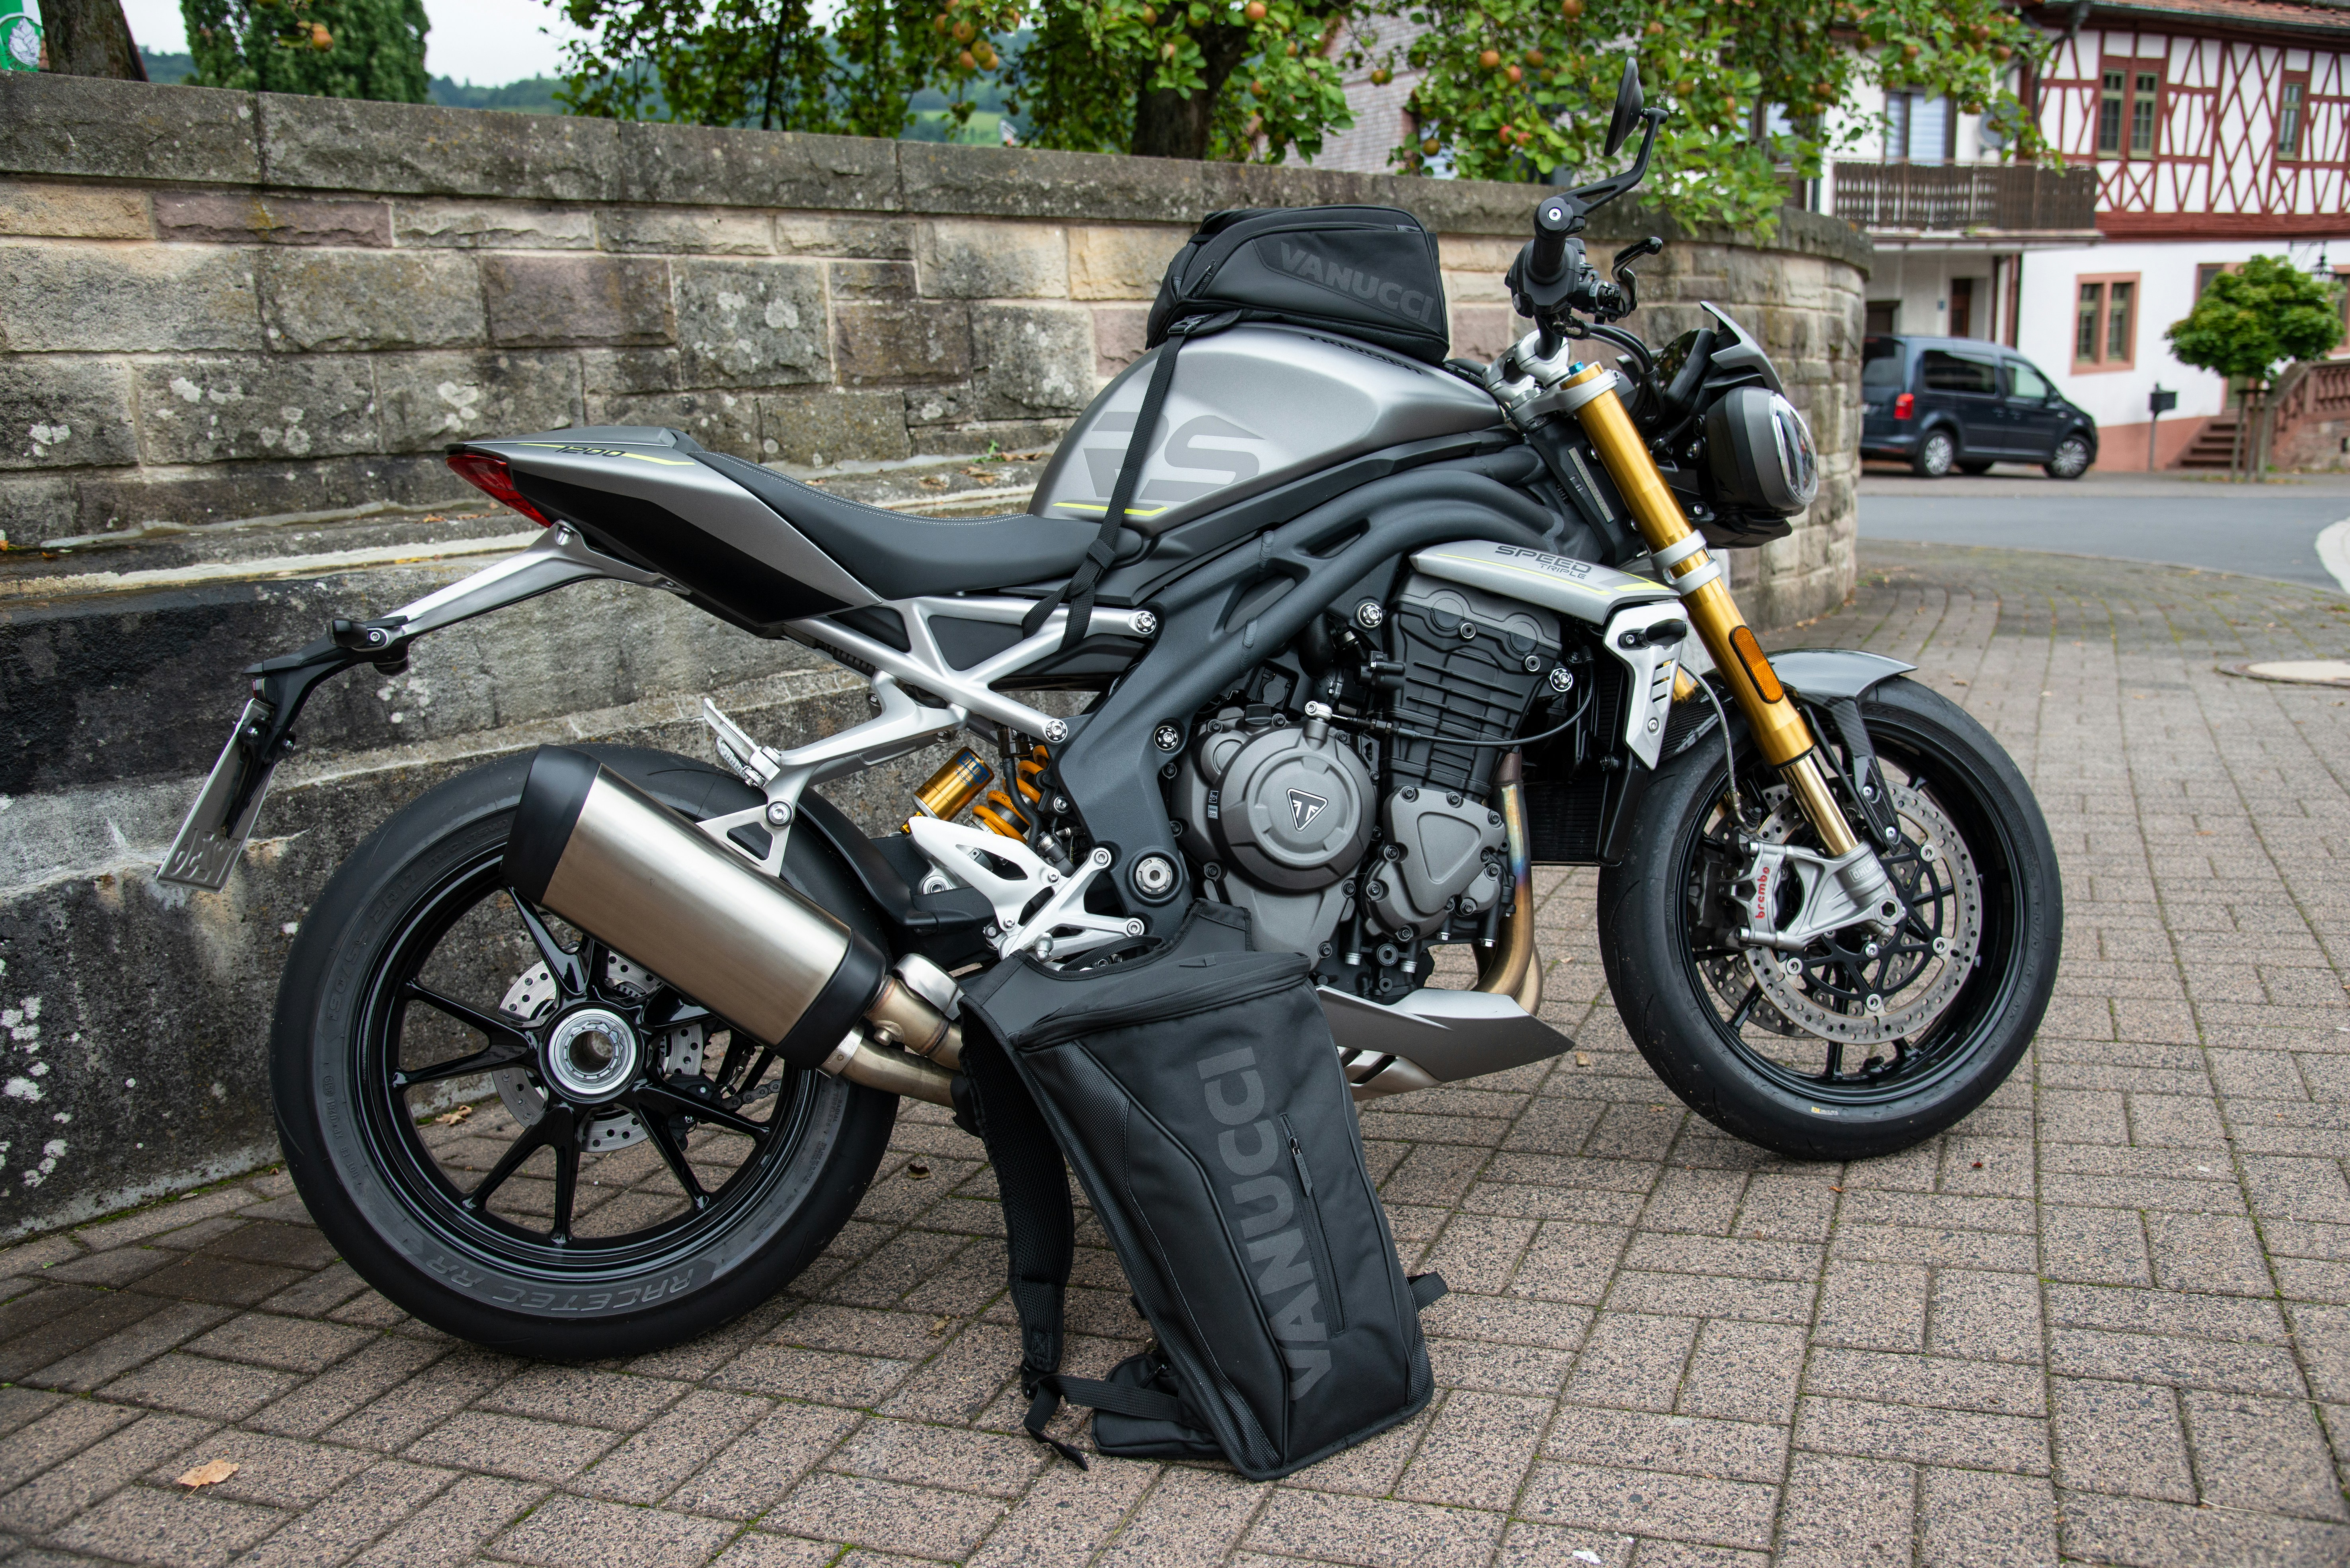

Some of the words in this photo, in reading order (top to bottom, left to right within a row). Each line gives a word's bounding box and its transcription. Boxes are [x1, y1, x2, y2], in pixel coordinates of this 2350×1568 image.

[1280, 242, 1434, 324] VANUCCI
[555, 446, 626, 458] 1200
[1495, 545, 1592, 574] SPEED
[1540, 563, 1587, 579] TRIPLE
[1851, 858, 1877, 880] ÖHLINS
[1755, 867, 1769, 918] brembo
[345, 1160, 360, 1178] DOT
[1196, 1046, 1332, 1400] VANUCCI
[426, 1254, 485, 1288] RR
[492, 1267, 696, 1312] RACETEC
